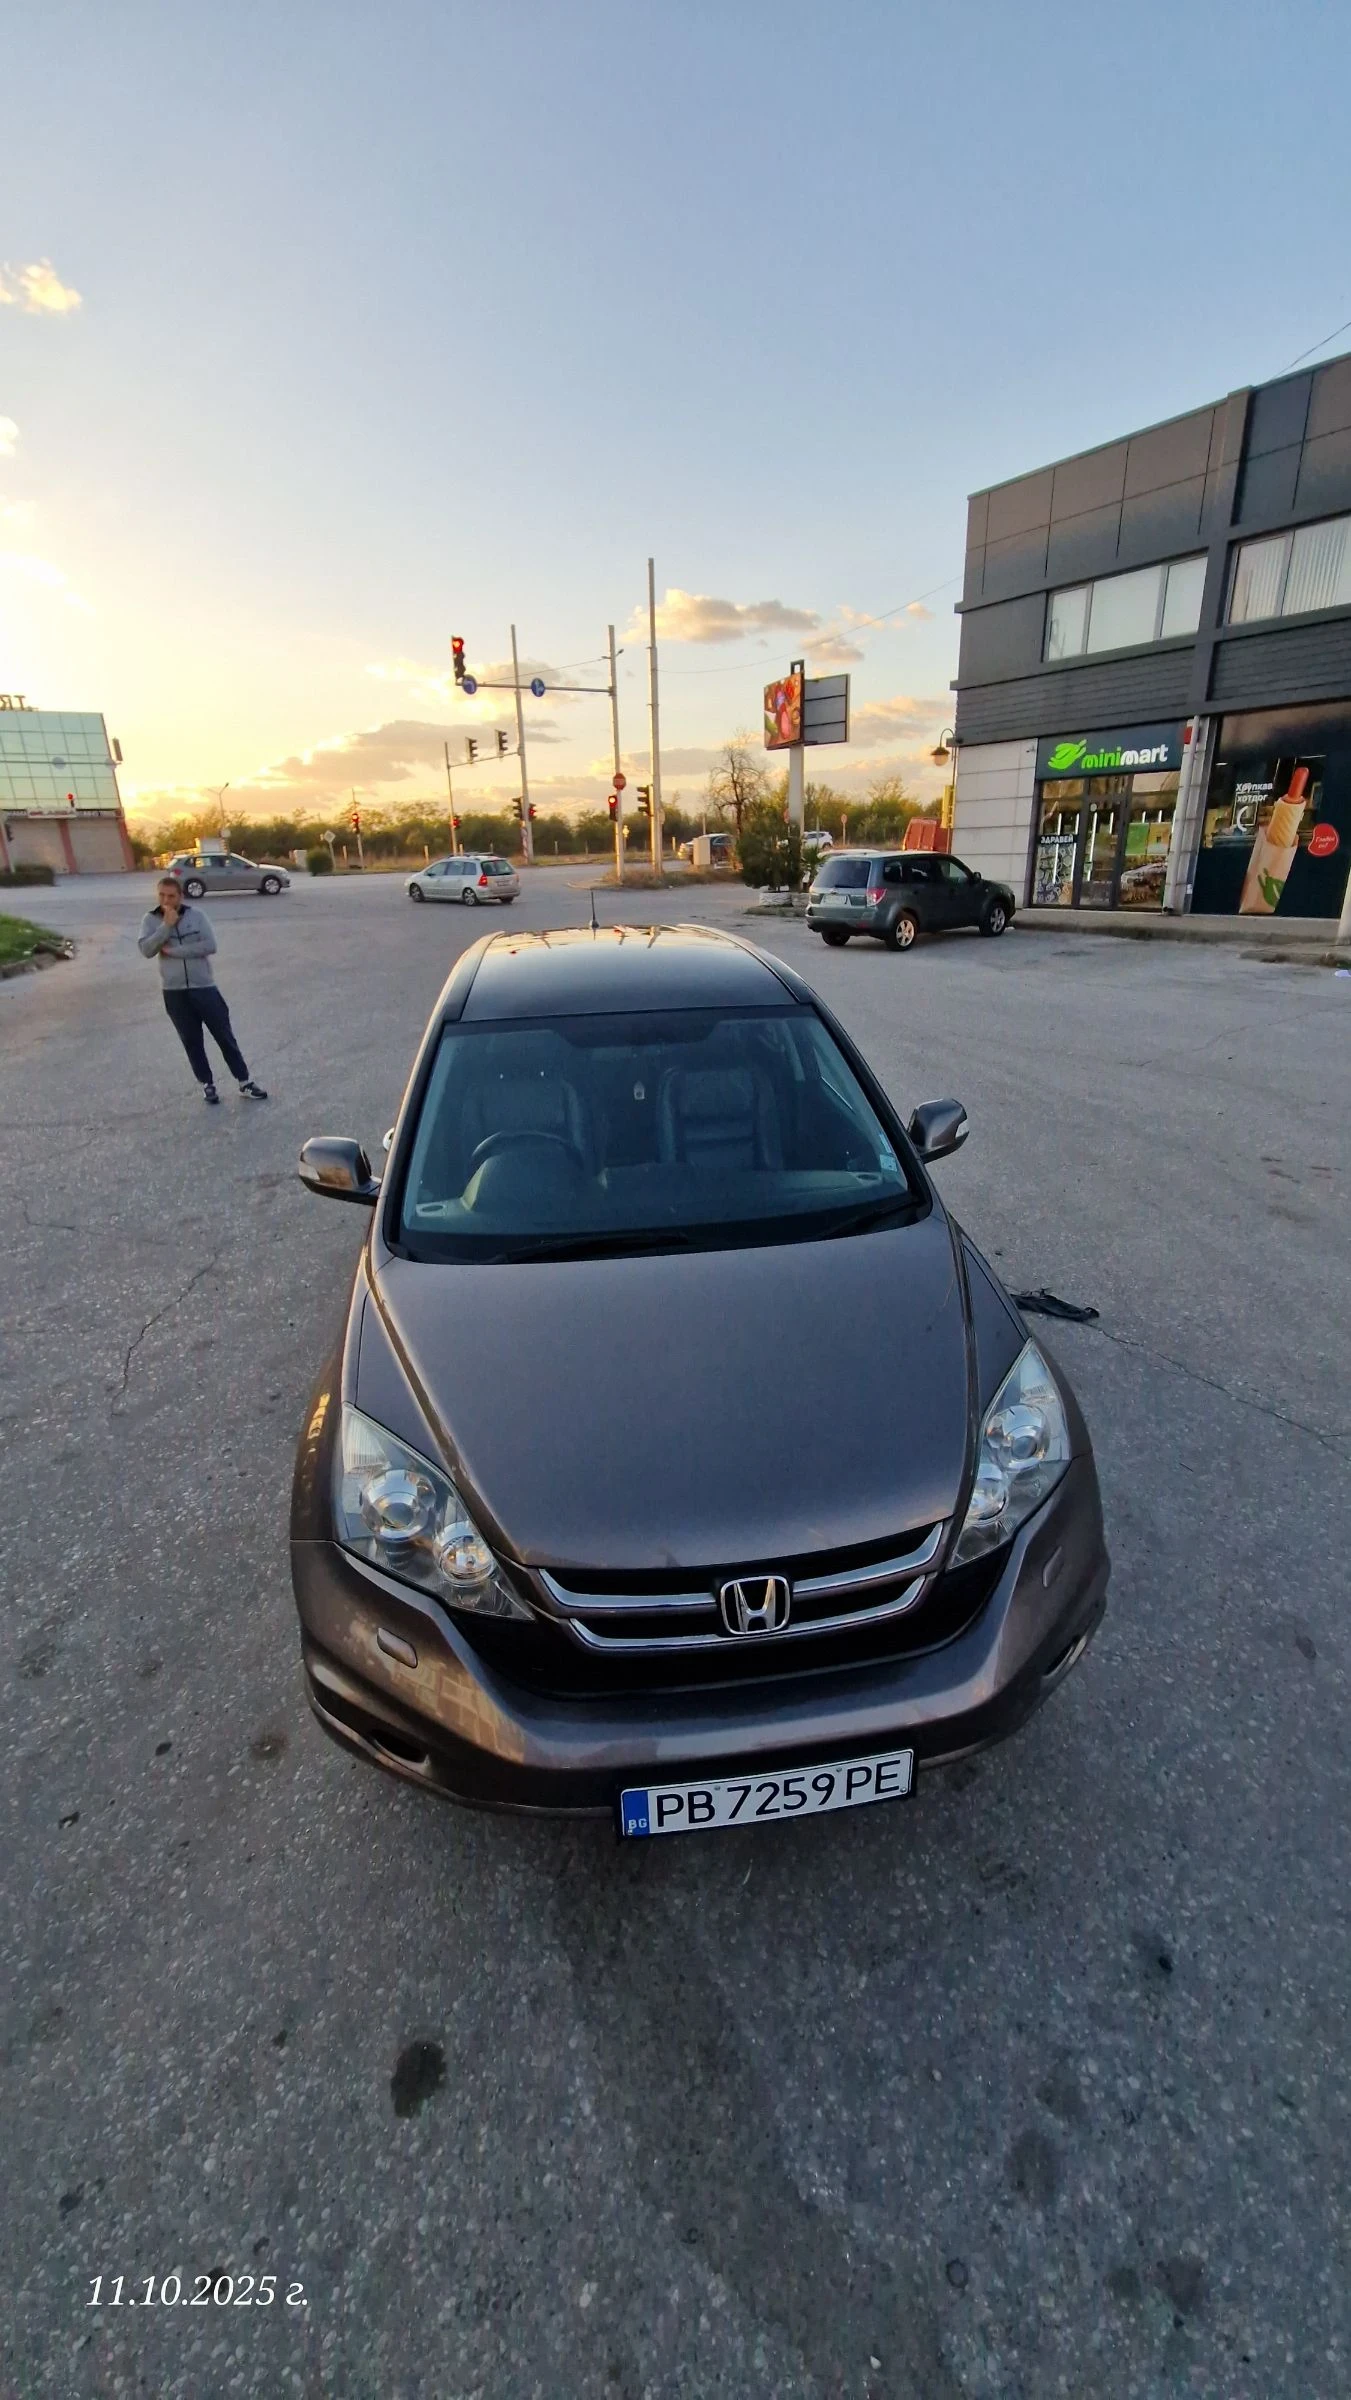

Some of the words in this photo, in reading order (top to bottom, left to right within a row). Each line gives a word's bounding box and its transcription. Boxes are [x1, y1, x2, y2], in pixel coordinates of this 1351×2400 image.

[1081, 744, 1169, 769] minimart
[1040, 833, 1074, 844] ЗДРАВЕЙ
[656, 1790, 715, 1828] PB
[727, 1773, 835, 1820] 7259
[845, 1759, 901, 1801] PE
[628, 1818, 648, 1829] BG
